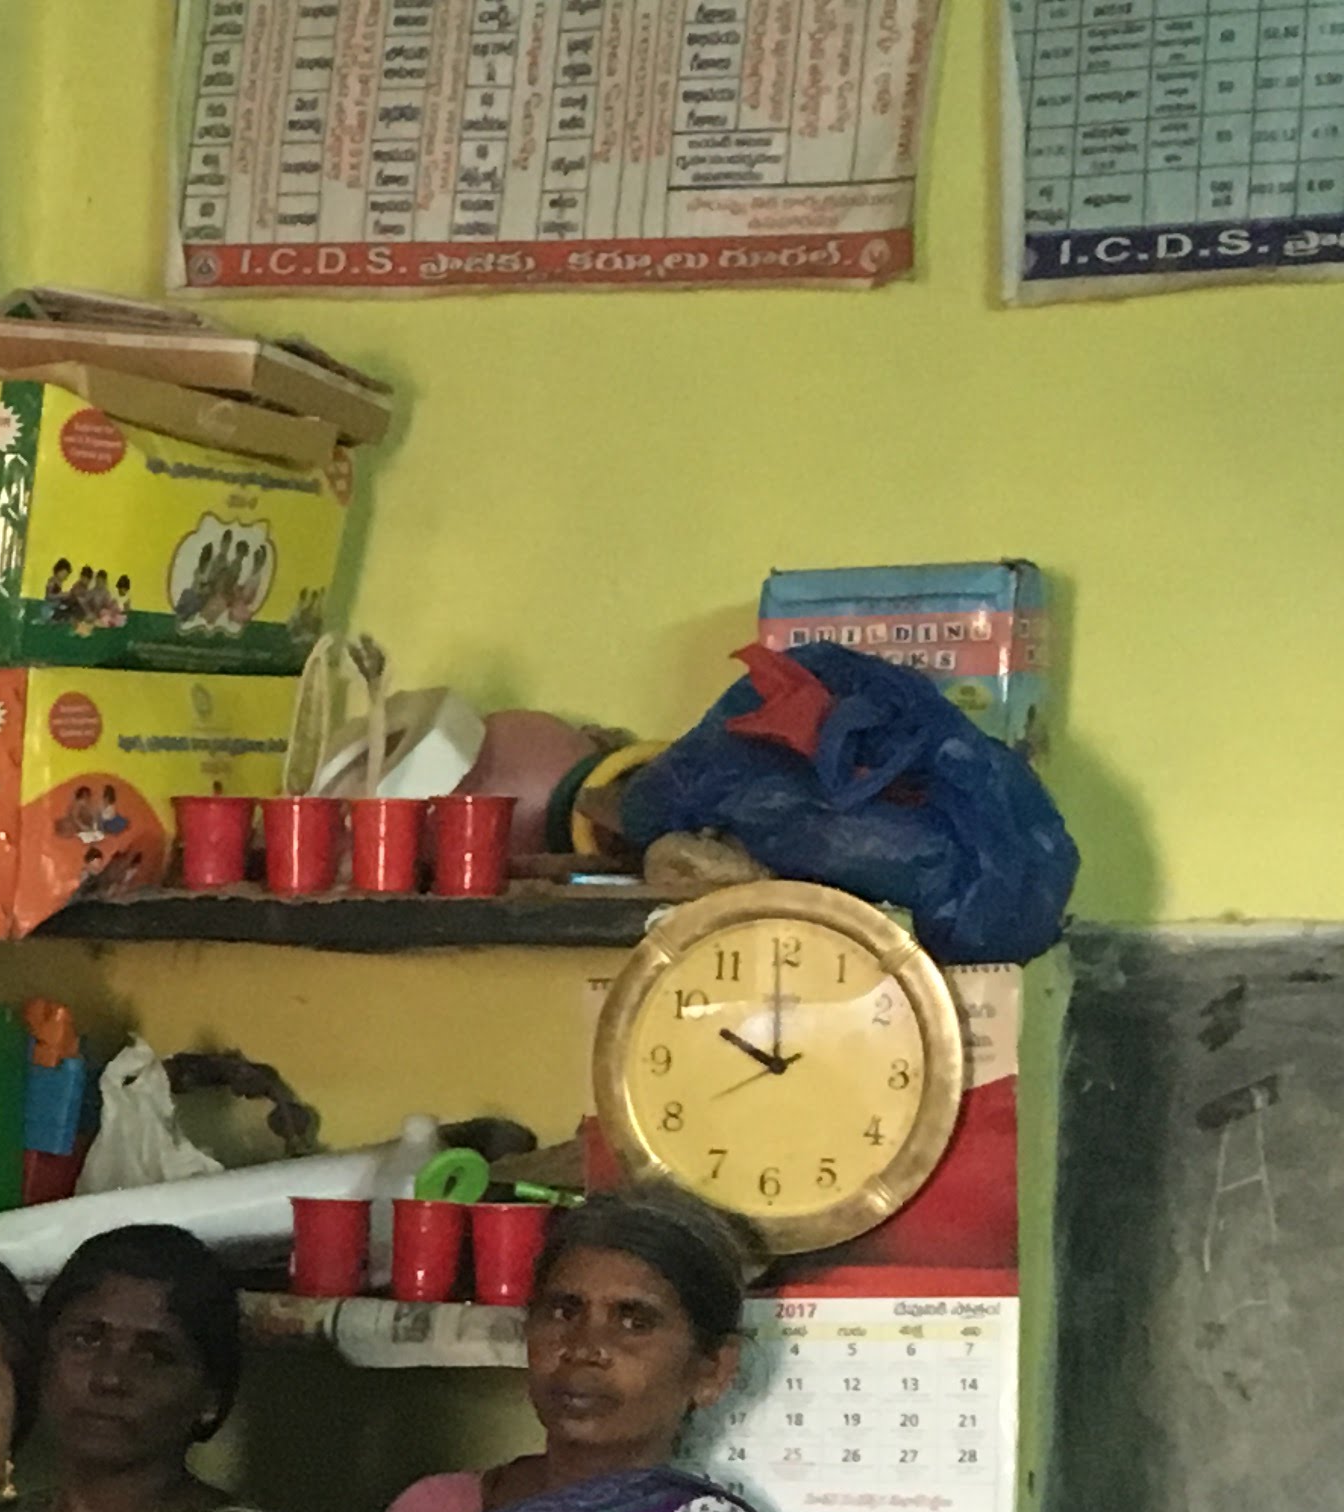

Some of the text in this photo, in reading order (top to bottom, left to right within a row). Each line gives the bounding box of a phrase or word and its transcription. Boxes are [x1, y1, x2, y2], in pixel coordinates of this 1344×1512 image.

[240, 246, 408, 275] I.C.D.S.
[1060, 229, 1270, 265] I.C.D.S.
[714, 950, 741, 981] 11
[772, 937, 802, 967] 12
[836, 953, 847, 983] 1
[675, 990, 709, 1020] 10
[872, 995, 894, 1026] 2
[650, 1045, 672, 1076] 9
[887, 1059, 910, 1090] 3
[662, 1101, 685, 1132] 8
[863, 1116, 885, 1146] 4
[708, 1149, 728, 1179] 7
[816, 1158, 838, 1189] 5
[759, 1167, 781, 1198] 6
[775, 1303, 817, 1319] 2017
[786, 1378, 803, 1391] 11
[843, 1378, 861, 1391] 12
[902, 1378, 919, 1392] 13
[960, 1378, 978, 1392] 14
[786, 1413, 804, 1426] 18
[844, 1413, 861, 1427] 19
[899, 1414, 919, 1428] 20
[958, 1414, 977, 1428] 21
[727, 1448, 978, 1464] 24 25 26 27 28
